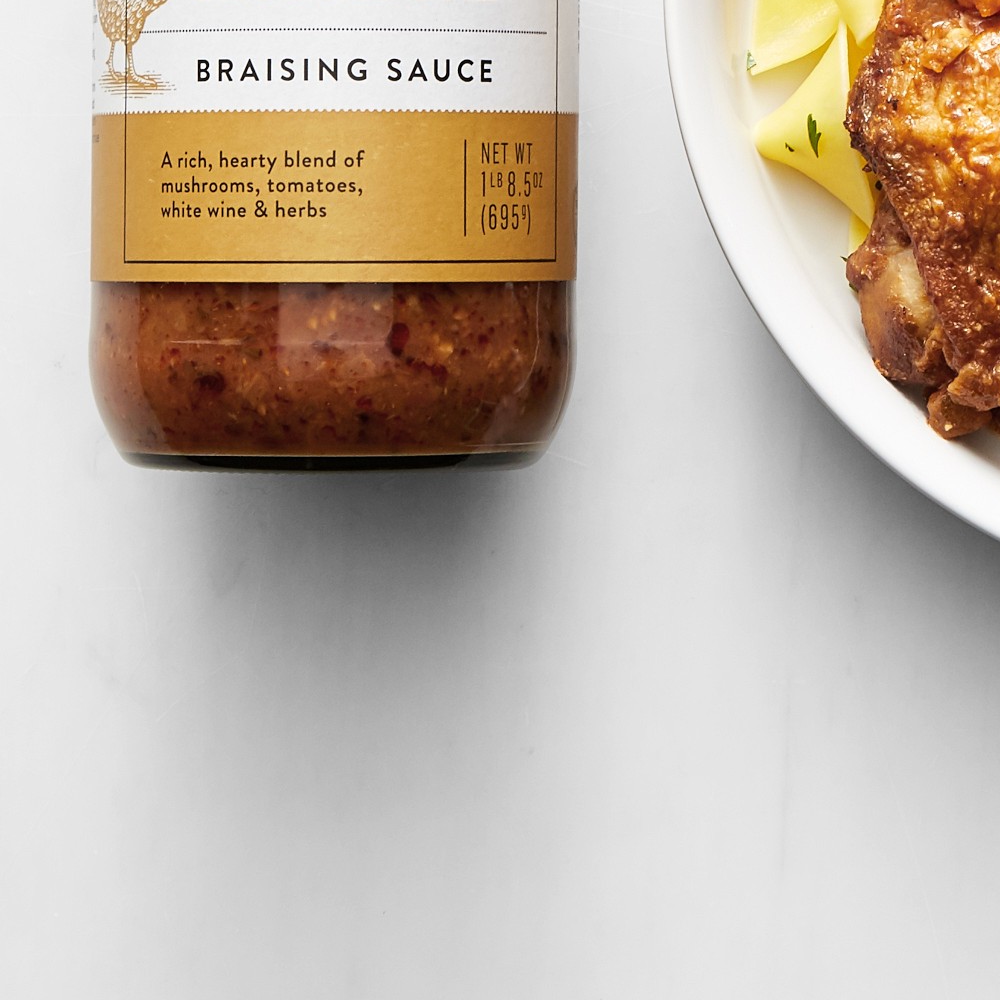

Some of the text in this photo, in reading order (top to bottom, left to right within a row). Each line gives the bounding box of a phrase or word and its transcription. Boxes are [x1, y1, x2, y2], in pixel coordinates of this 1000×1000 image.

[197, 58, 493, 83] BRAISING SAUCE
[160, 150, 366, 174] A rich, hearty blend of
[481, 142, 533, 164] NET WT
[161, 176, 363, 196] mushrooms, tomatoes,
[161, 202, 328, 219] white wine & herbs
